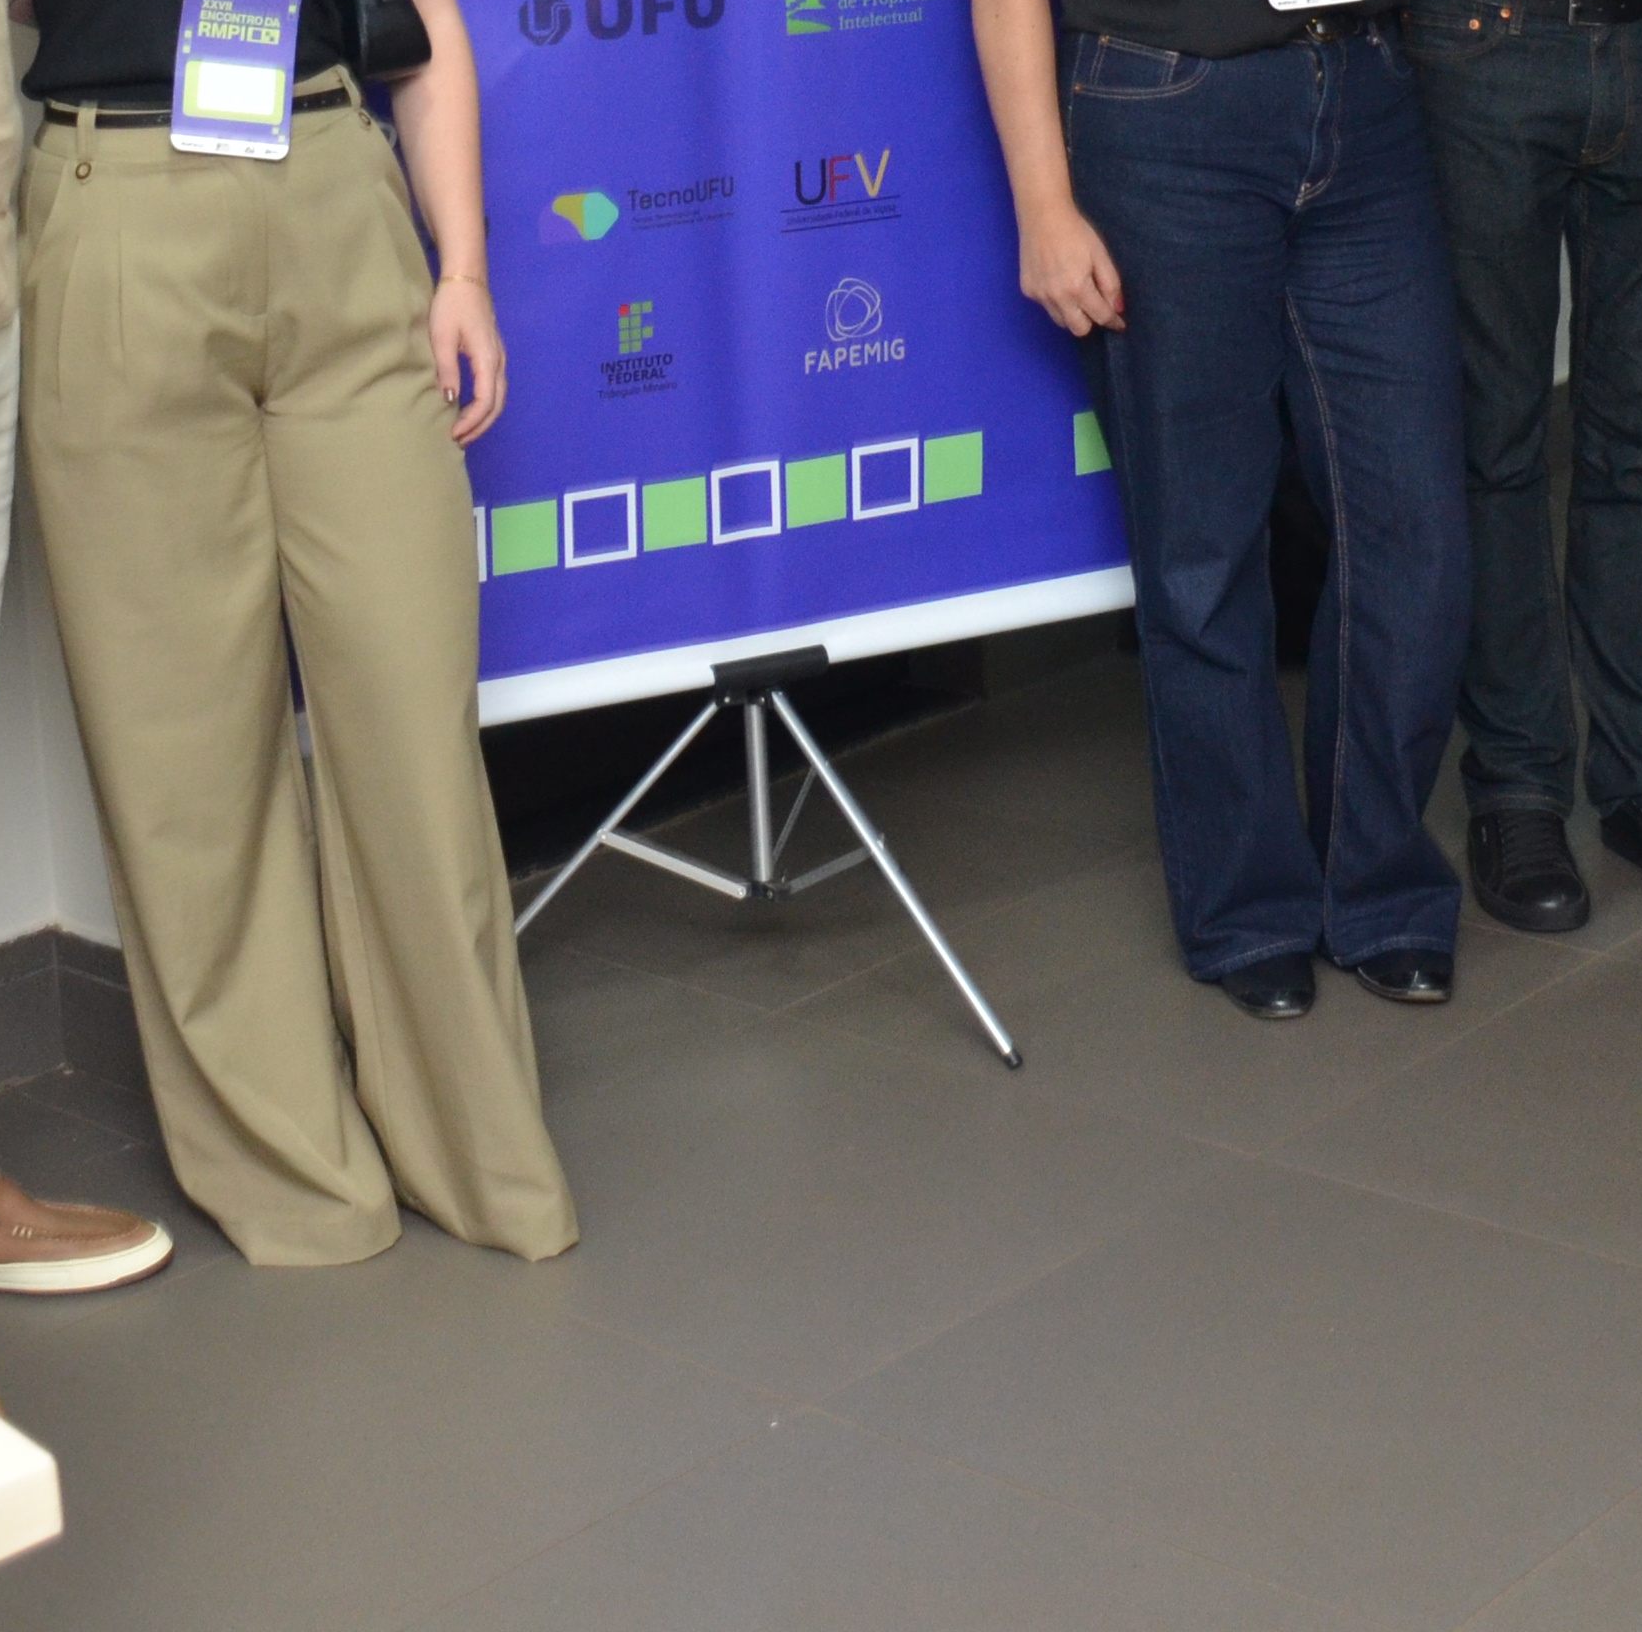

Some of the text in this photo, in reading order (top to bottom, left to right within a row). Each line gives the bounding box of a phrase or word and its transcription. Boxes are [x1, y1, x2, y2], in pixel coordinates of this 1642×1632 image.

[199, 9, 281, 28] ENCONTRO DA
[839, 8, 923, 30] Intelectual
[198, 21, 245, 41] RMPI
[795, 148, 891, 205] UFV
[628, 176, 735, 211] TecnoUFU
[600, 353, 673, 374] INSTITUTO
[804, 338, 905, 374] FAPEMIG
[607, 367, 667, 385] FEDERAL
